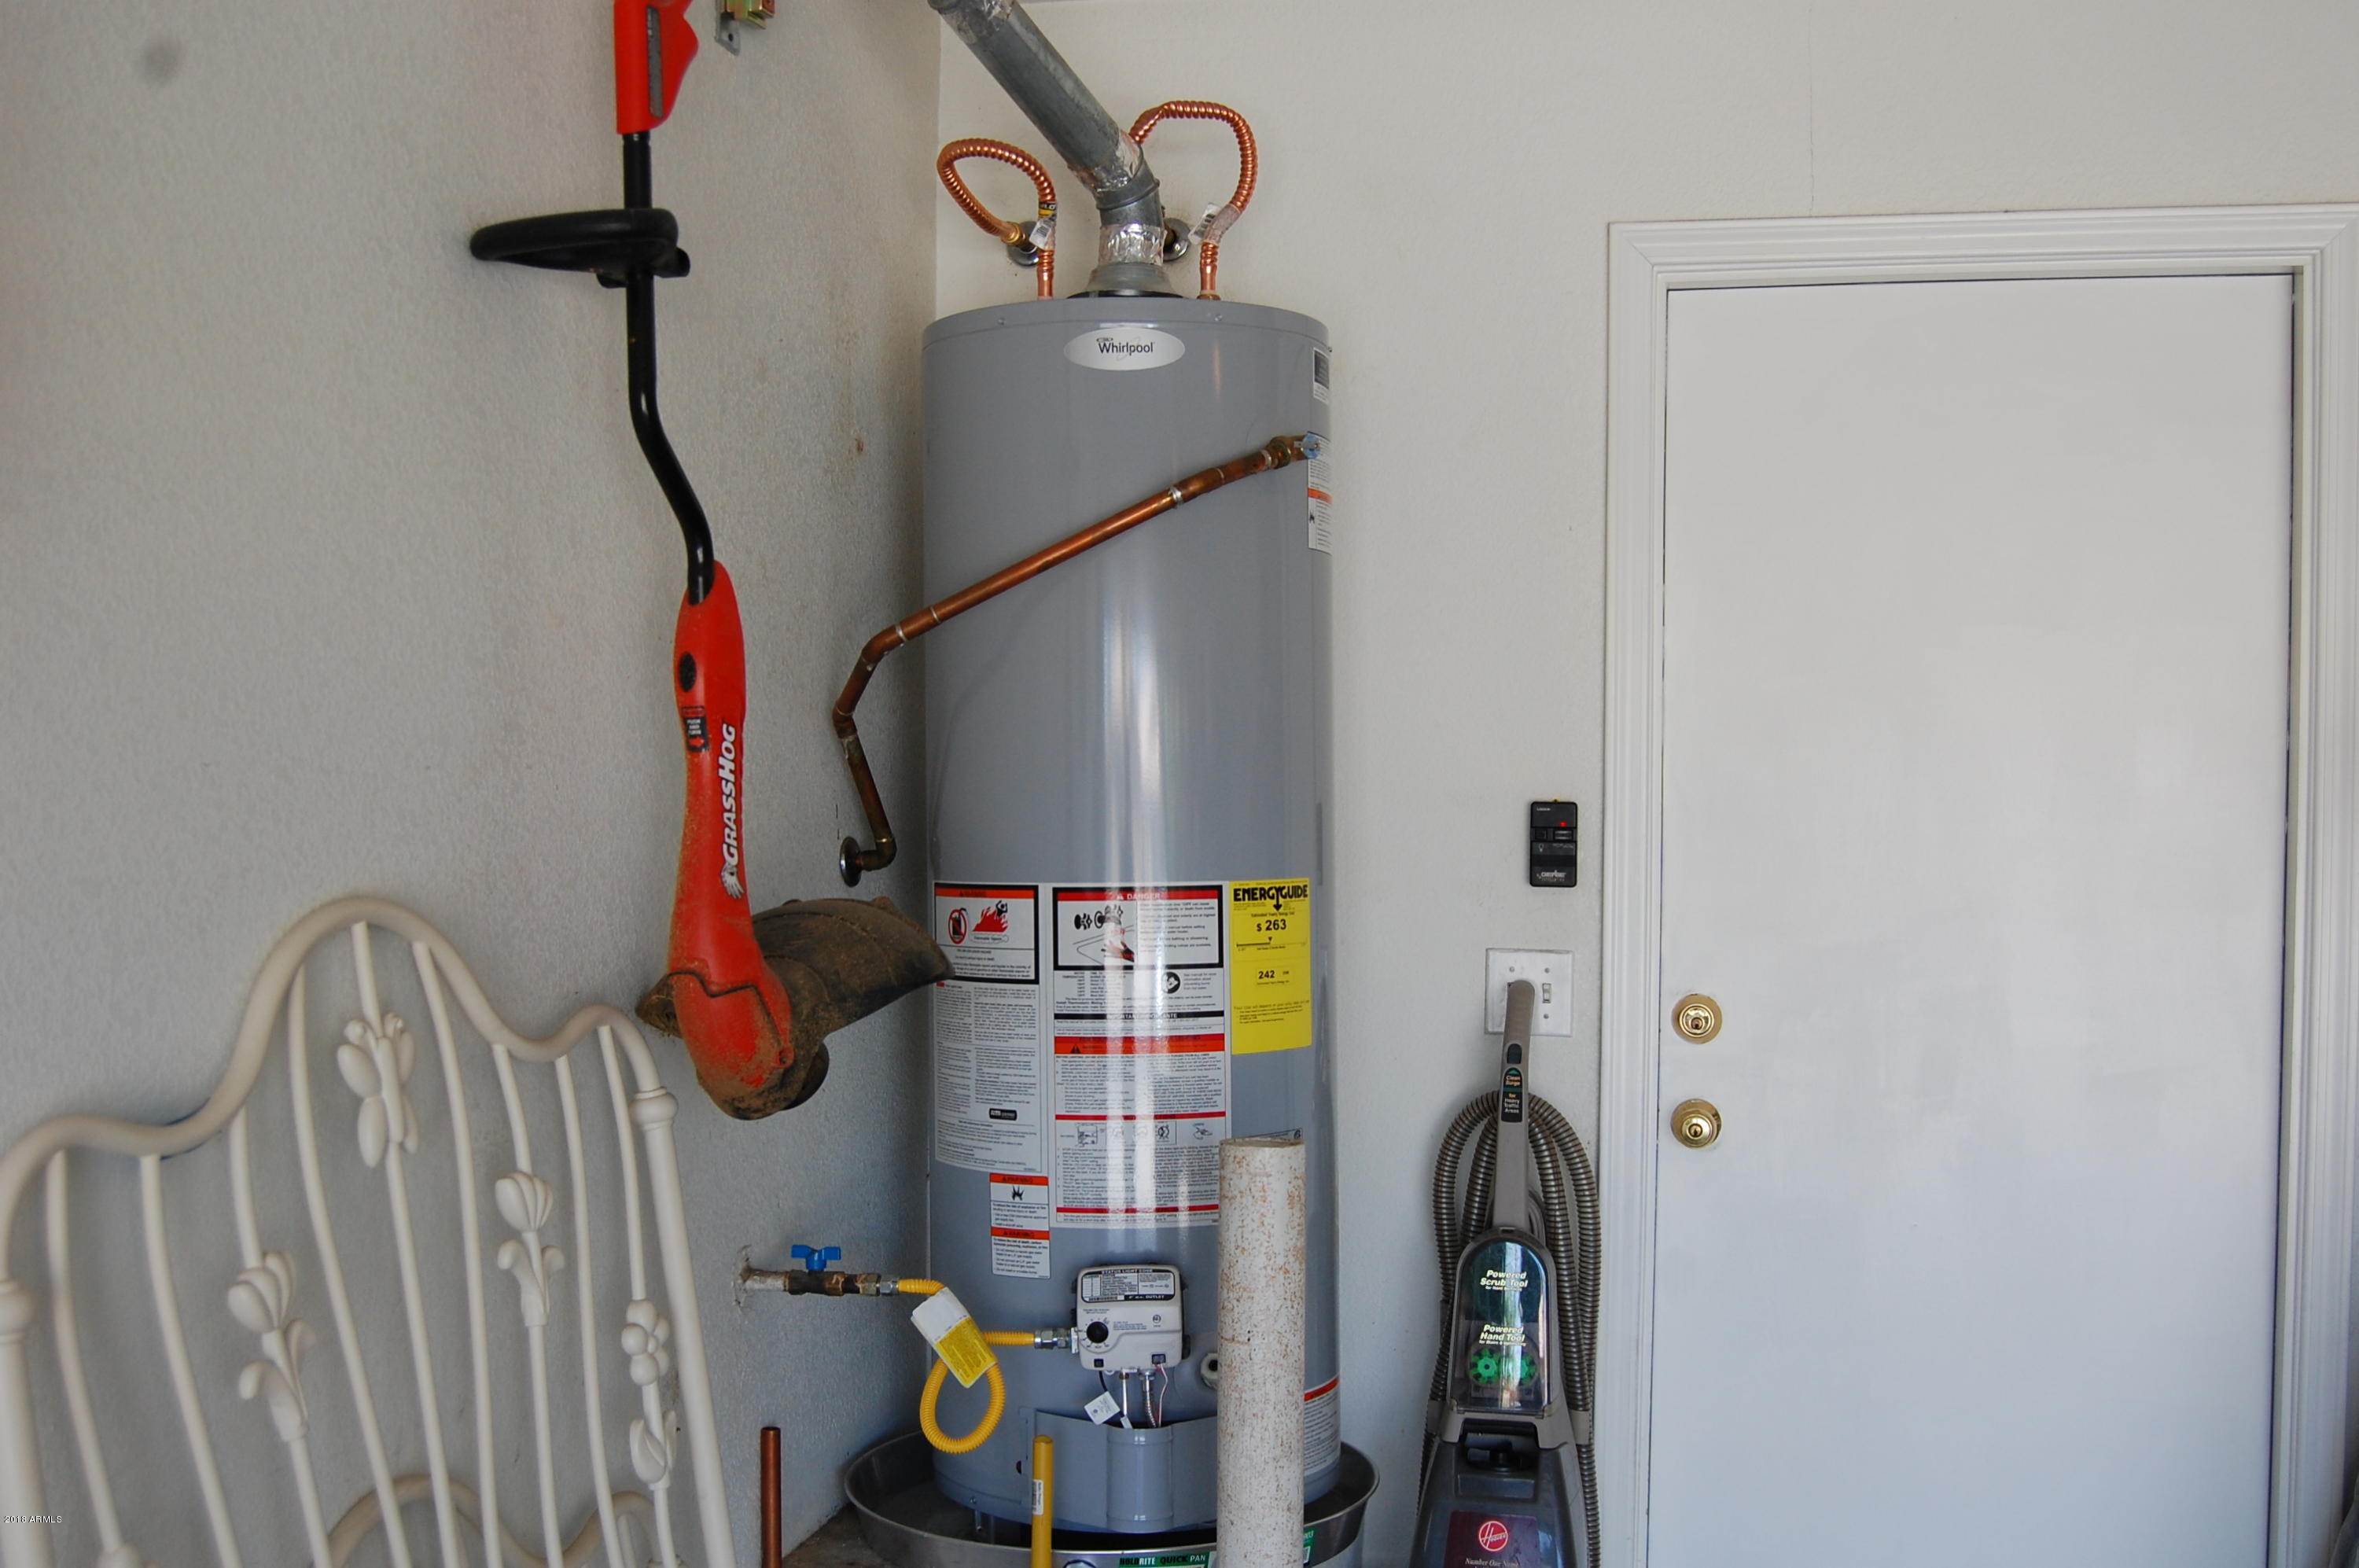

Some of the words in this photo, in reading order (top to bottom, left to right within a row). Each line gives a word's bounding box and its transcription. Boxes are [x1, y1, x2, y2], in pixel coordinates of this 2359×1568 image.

[1098, 341, 1154, 355] Whirlpool
[718, 723, 739, 866] GRASSHOG
[1233, 885, 1308, 903] ENERGYGUIDE
[1257, 922, 1262, 932] $
[1265, 918, 1286, 931] 263
[1258, 970, 1275, 980] 242
[1486, 1269, 1527, 1279] Powered
[1480, 1277, 1507, 1286] Scrub
[1510, 1279, 1529, 1287] Tool
[1483, 1324, 1524, 1334] Powered
[1480, 1331, 1505, 1341] Hand
[1507, 1333, 1525, 1342] Tool
[1160, 1555, 1188, 1564] QUICK
[1190, 1554, 1206, 1562] PAN
[1465, 1557, 1489, 1566] Number
